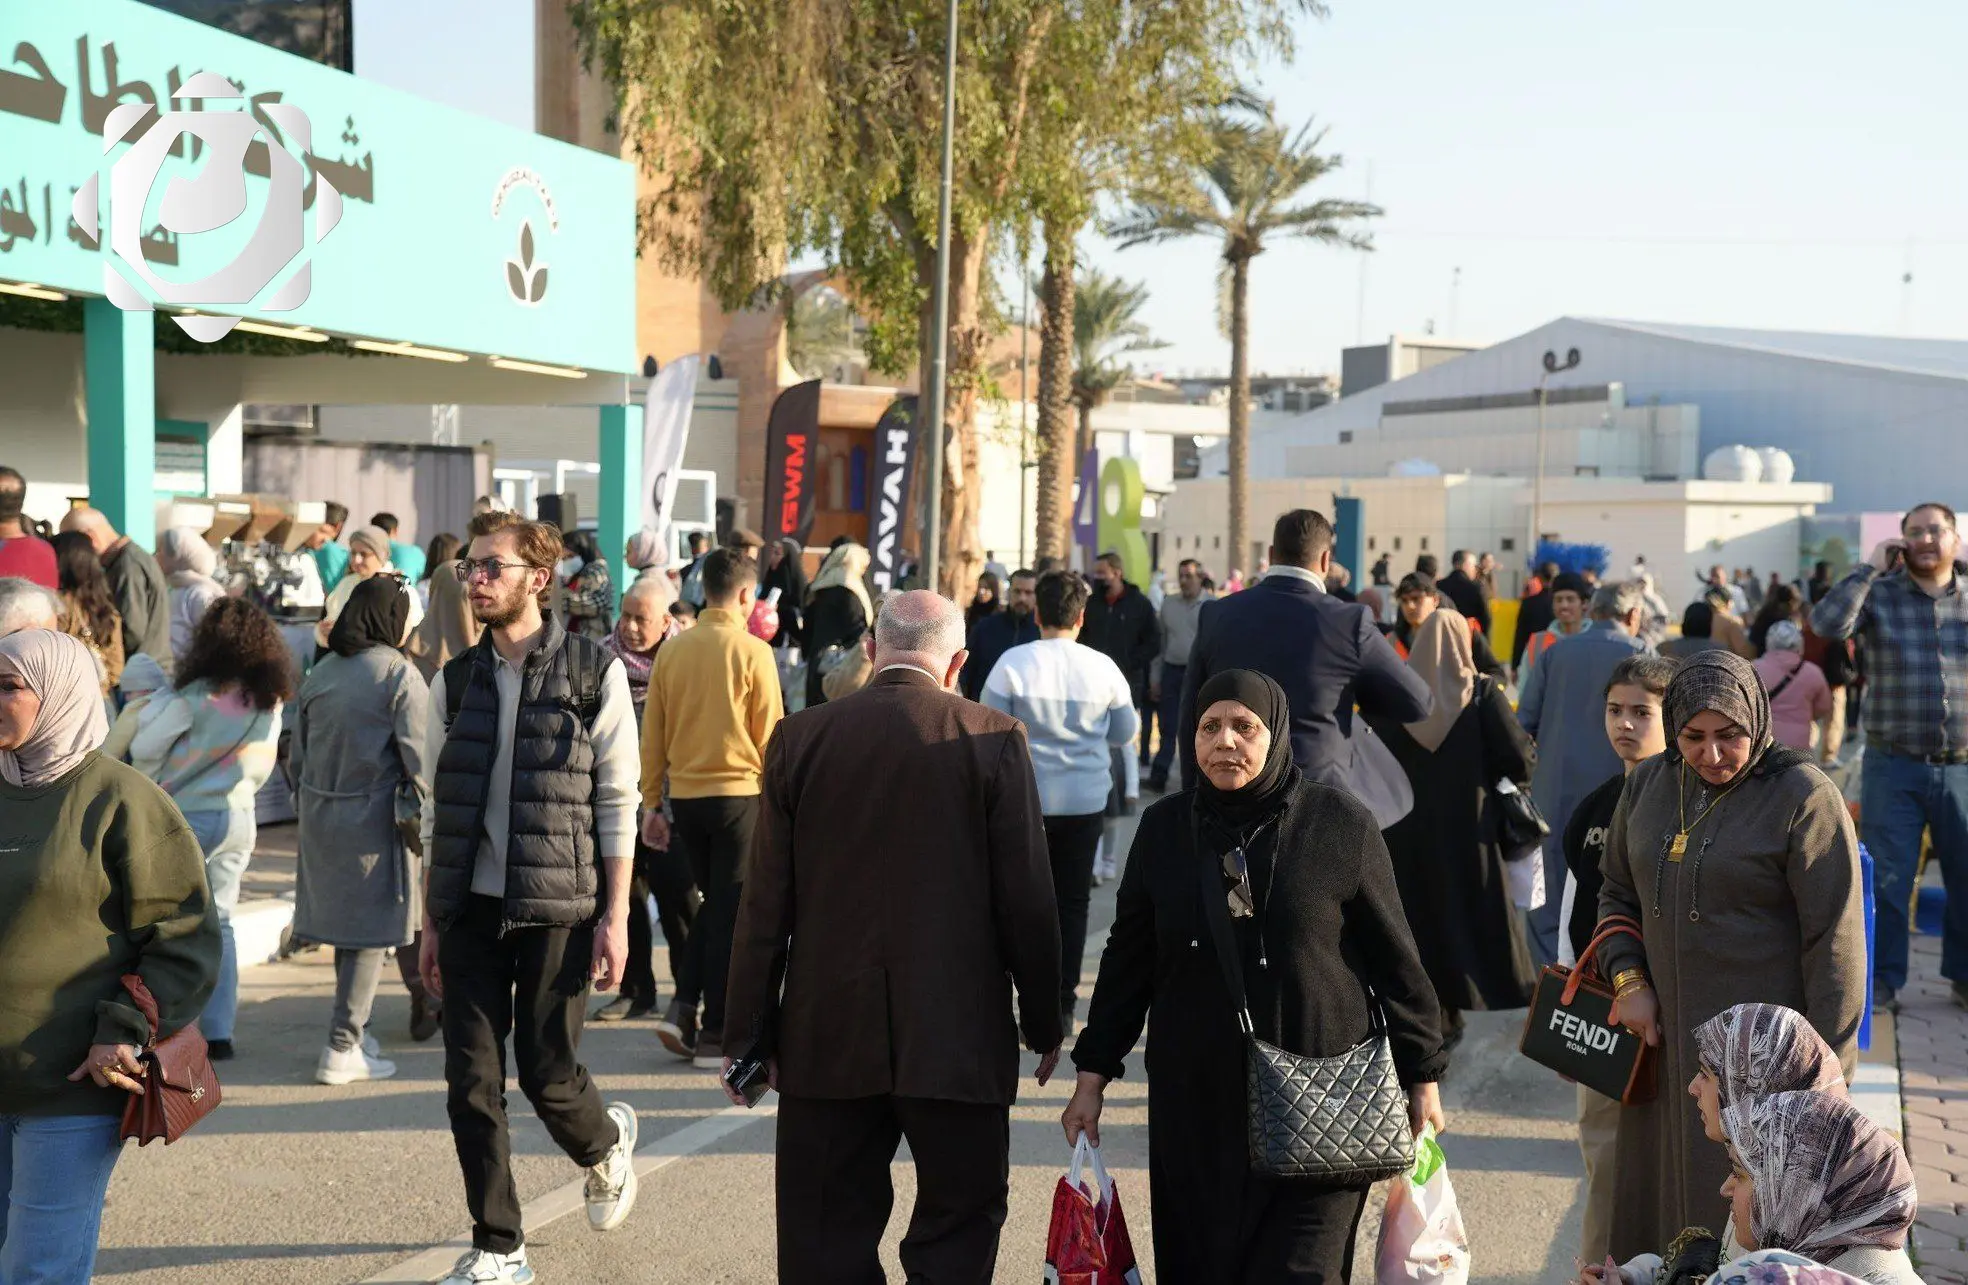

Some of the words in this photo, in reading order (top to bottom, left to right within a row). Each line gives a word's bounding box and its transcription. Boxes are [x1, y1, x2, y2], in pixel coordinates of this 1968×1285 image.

[781, 434, 807, 534] GWM
[1549, 1008, 1619, 1055] FENDI
[1566, 1041, 1588, 1056] ROMA
